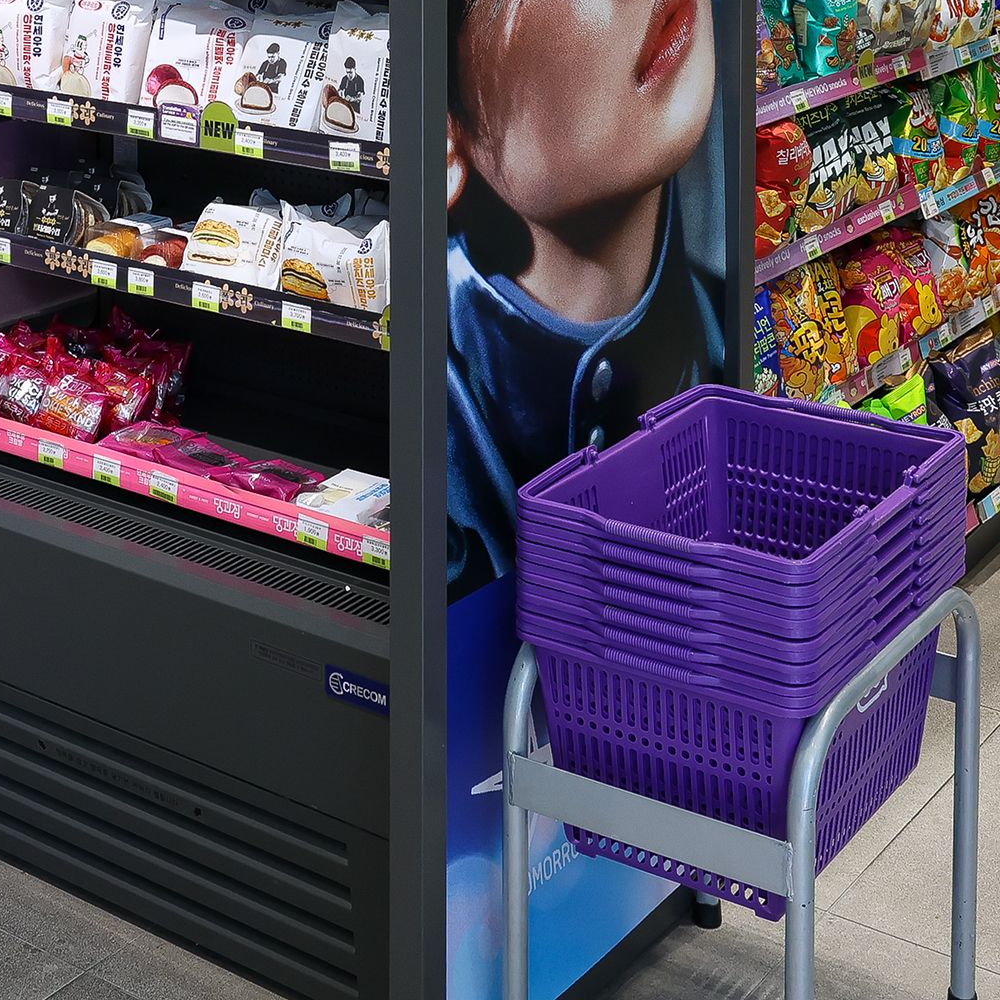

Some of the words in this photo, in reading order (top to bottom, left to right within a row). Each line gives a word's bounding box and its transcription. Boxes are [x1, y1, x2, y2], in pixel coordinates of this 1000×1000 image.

[32, 14, 44, 58] 연세우유
[113, 24, 125, 68] 연세우유
[301, 42, 322, 88] 밤티라미수
[805, 83, 829, 98] HEYROO
[829, 78, 847, 90] snacks
[289, 89, 308, 127] 생크림빵
[204, 120, 235, 140] NEW
[912, 135, 927, 152] 20
[857, 210, 880, 225] exclusive
[823, 227, 841, 243] snacks
[343, 681, 387, 707] CRECOM
